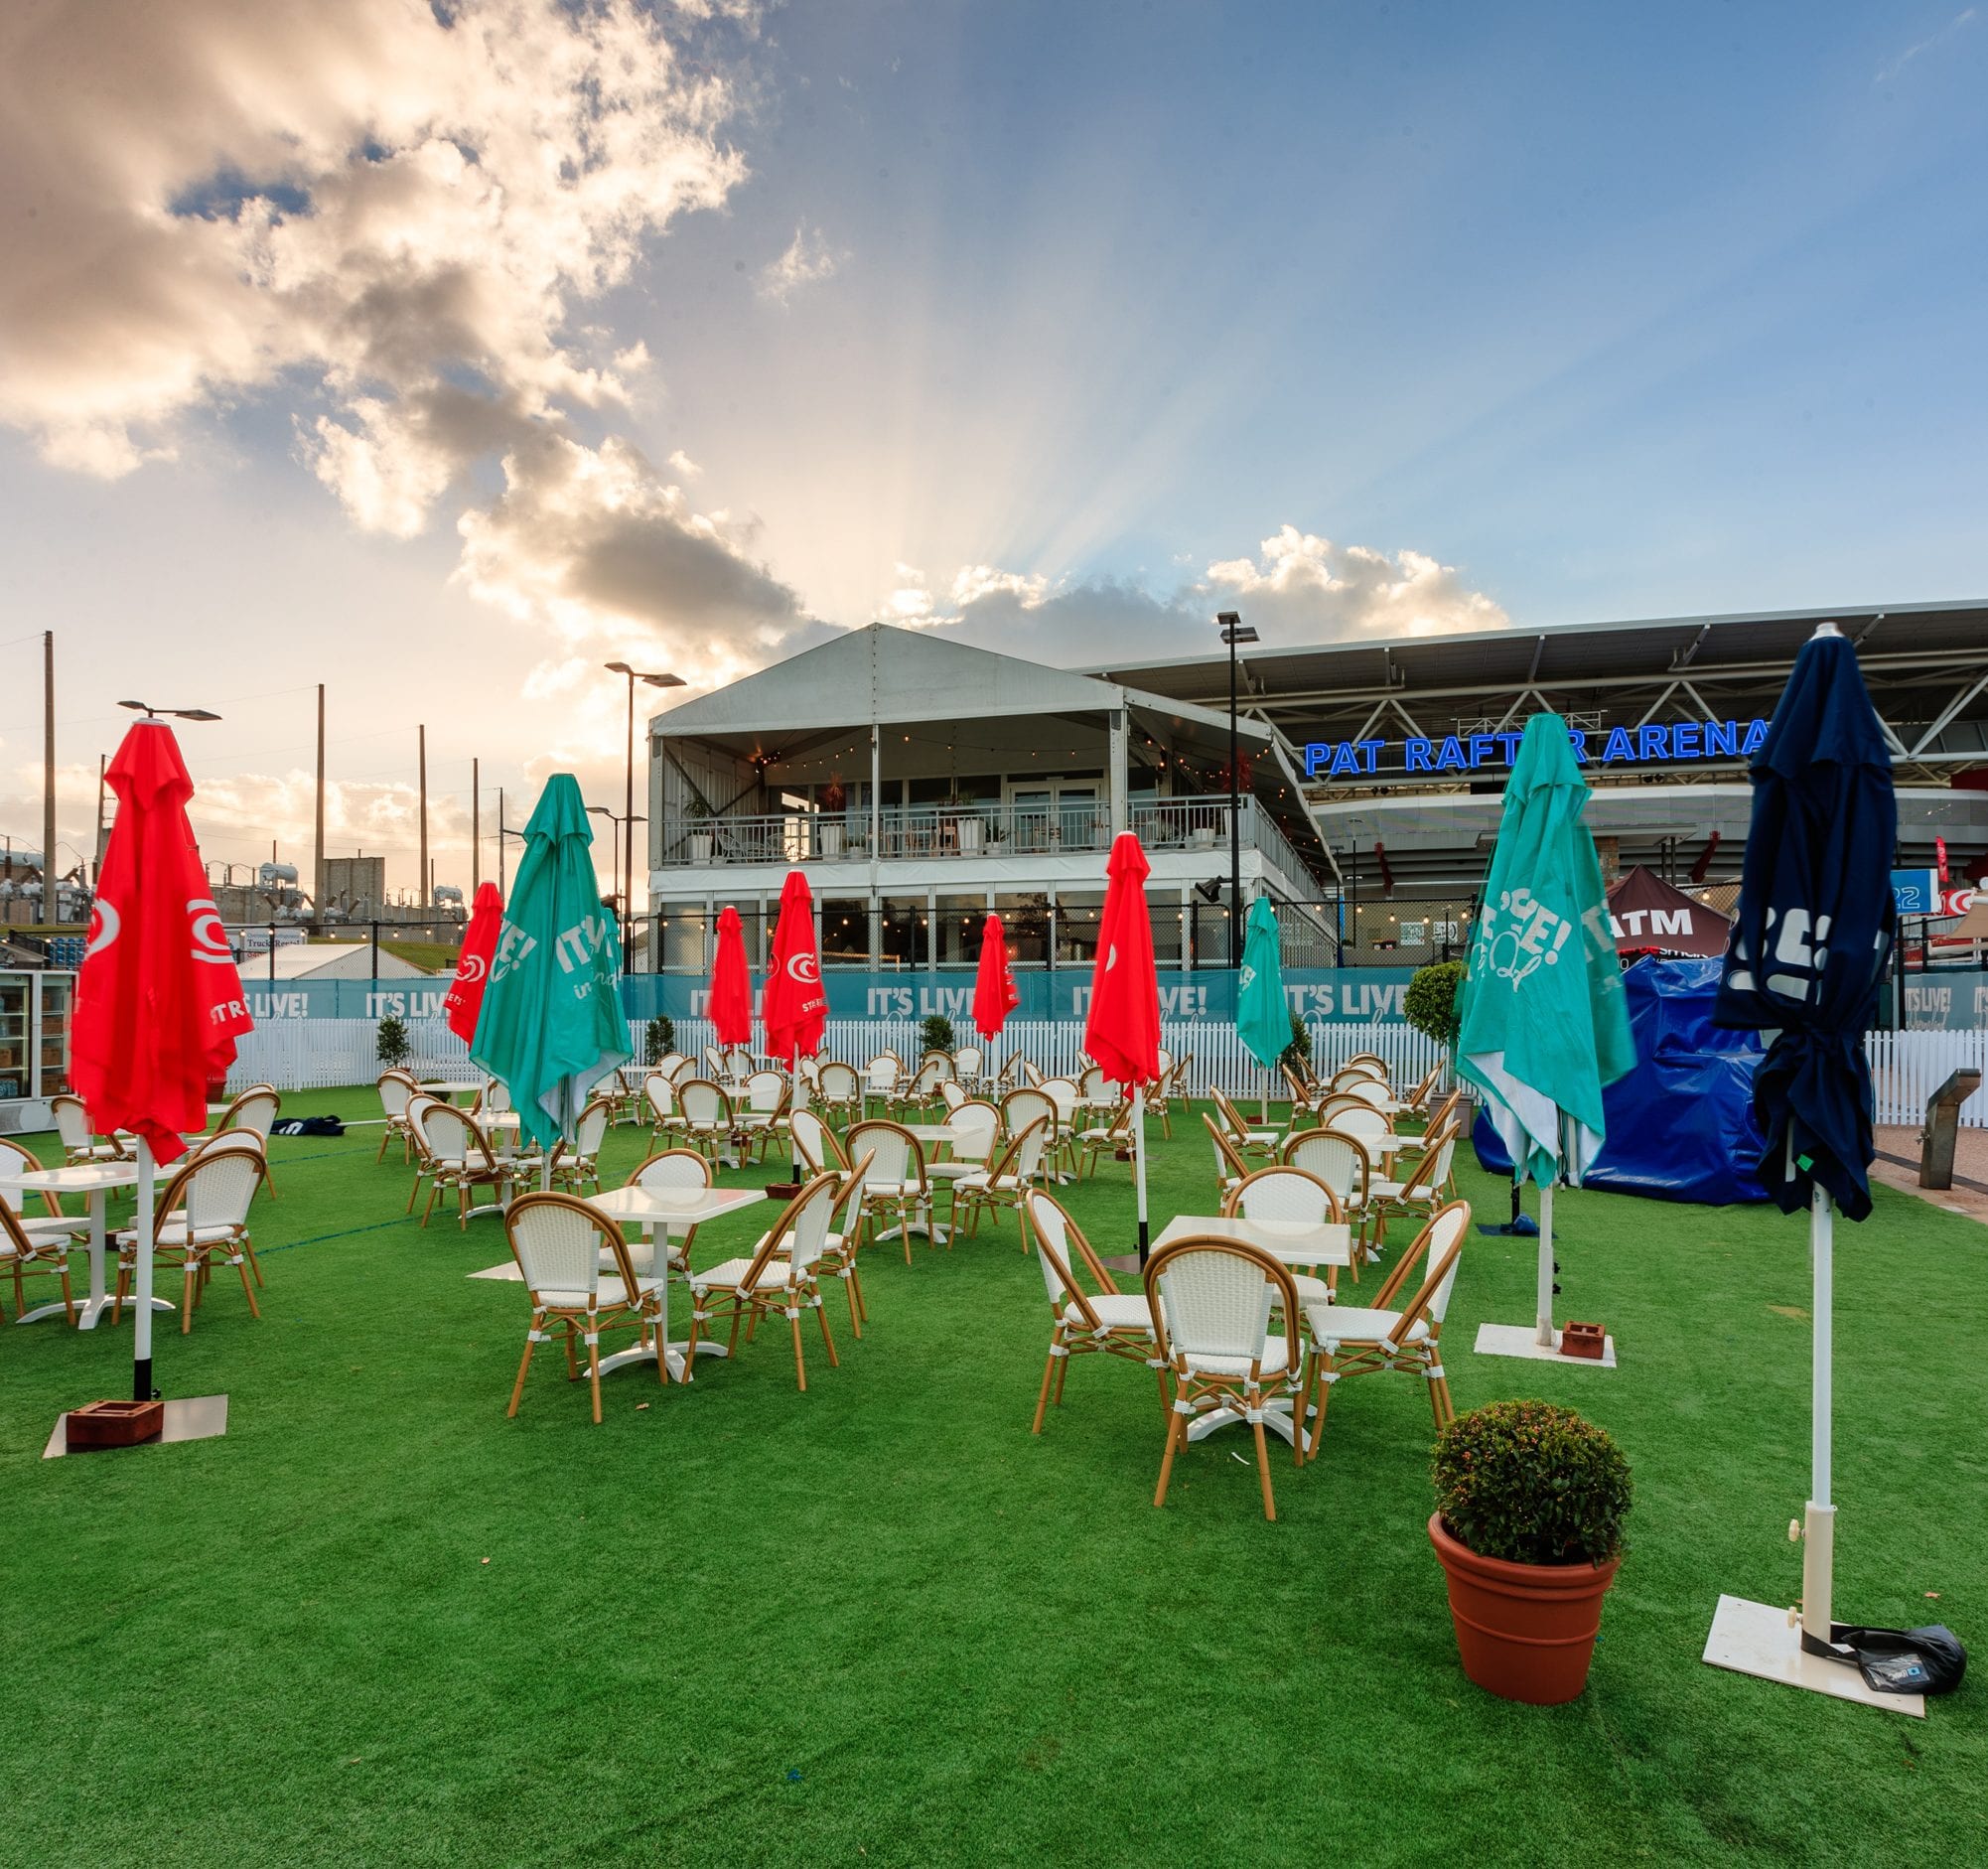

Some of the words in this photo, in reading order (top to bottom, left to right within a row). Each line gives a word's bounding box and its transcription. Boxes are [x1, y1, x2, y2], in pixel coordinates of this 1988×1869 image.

[1305, 740, 1386, 777] PAT
[1404, 731, 1588, 773] RAFTR
[1601, 718, 1772, 763] ARENA
[247, 938, 272, 948] Truck
[254, 993, 309, 1018] LIVE!
[365, 992, 406, 1018] IT'S
[410, 992, 451, 1018] LIV
[691, 989, 713, 1017] IT
[867, 987, 915, 1016] IT'S
[1072, 986, 1093, 1016] IT
[1157, 986, 1207, 1016] VE!
[1343, 984, 1409, 1015] LIVE
[1921, 987, 1952, 1012] LIVE!
